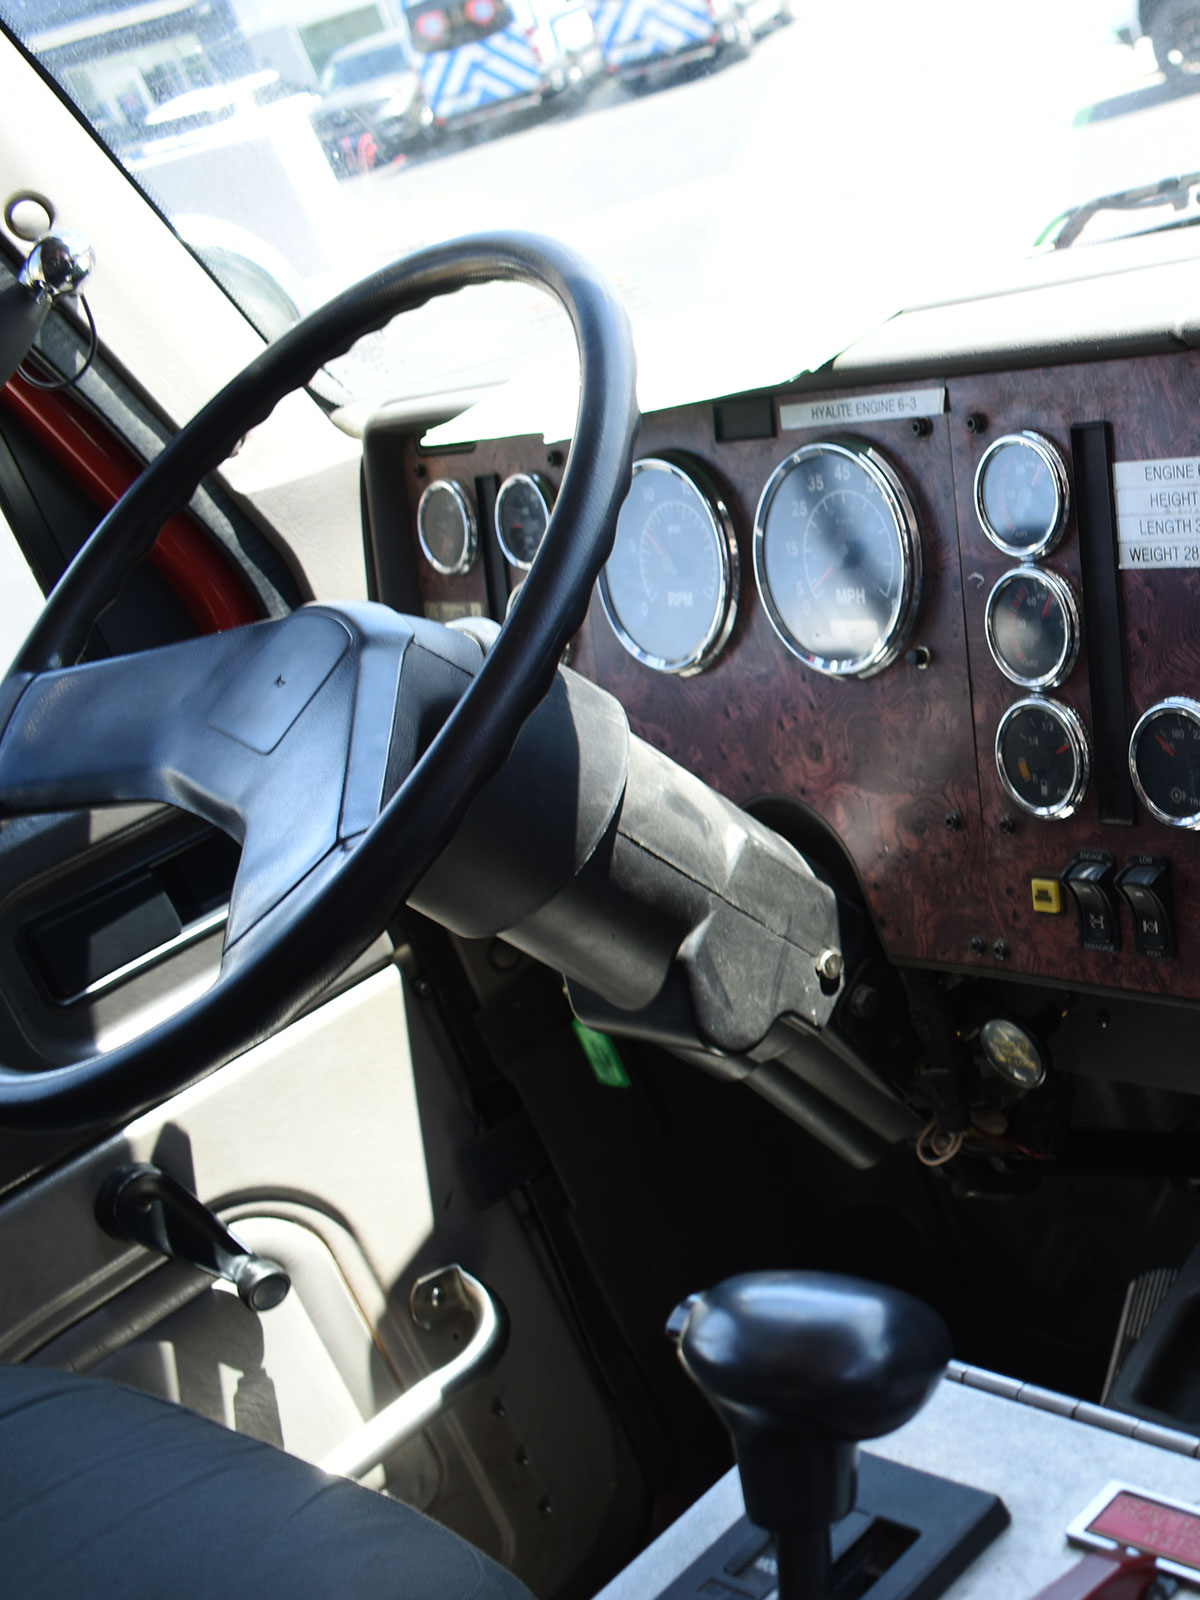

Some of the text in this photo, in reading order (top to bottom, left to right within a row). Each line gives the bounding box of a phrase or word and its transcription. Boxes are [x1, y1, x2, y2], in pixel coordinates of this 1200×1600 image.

[811, 396, 917, 420] HYALITE ENGINE 6-3
[834, 464, 850, 481] 45
[1145, 464, 1194, 481] ENGINE
[808, 475, 824, 491] 35
[1150, 491, 1198, 508] HEIGHT
[792, 501, 807, 517] 25
[1140, 519, 1192, 536] LENGTH
[786, 541, 799, 557] 15
[1129, 546, 1179, 563] WEIGHT
[1184, 546, 1199, 561] 28
[668, 591, 693, 607] RPM
[835, 587, 866, 605] MPH
[1080, 852, 1104, 861] ENGAGE
[1139, 856, 1153, 865] LOW
